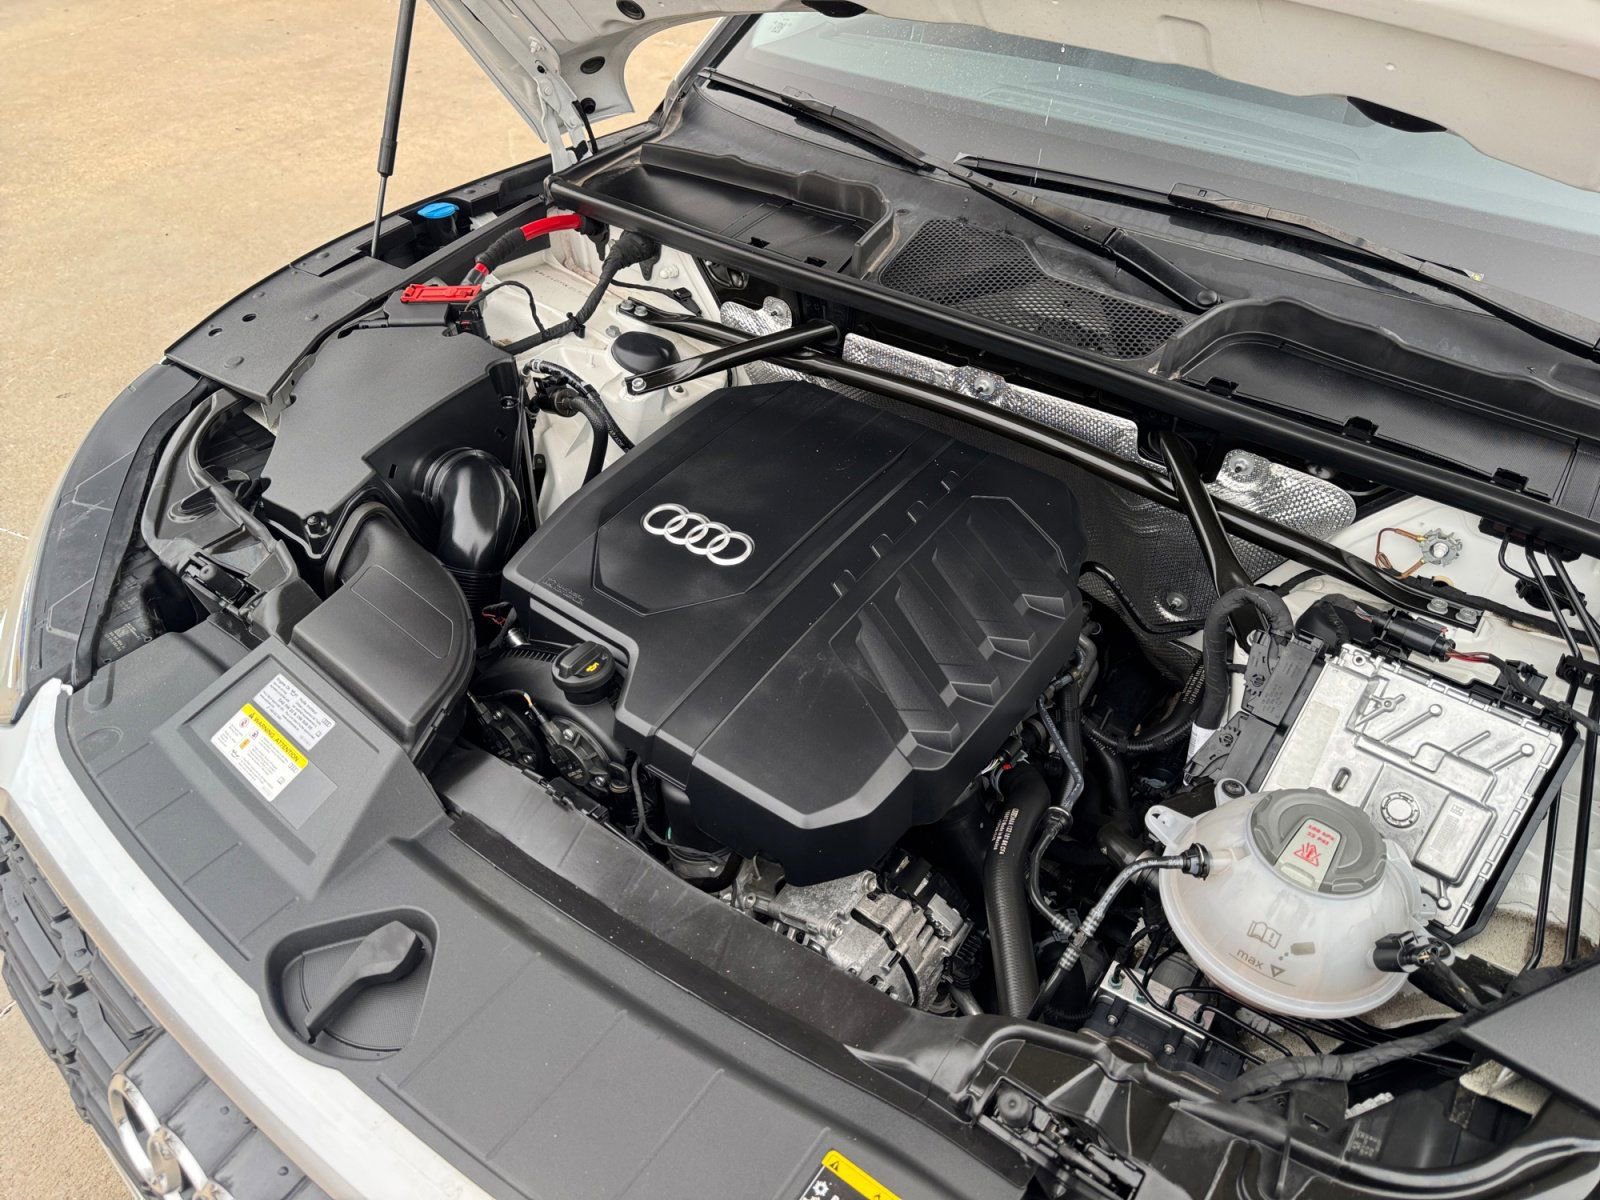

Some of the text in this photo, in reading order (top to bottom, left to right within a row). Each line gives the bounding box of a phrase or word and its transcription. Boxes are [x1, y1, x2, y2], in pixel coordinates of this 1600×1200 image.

[254, 717, 277, 739] WARNING
[276, 737, 299, 761] ATTENTION
[1236, 948, 1263, 969] max
